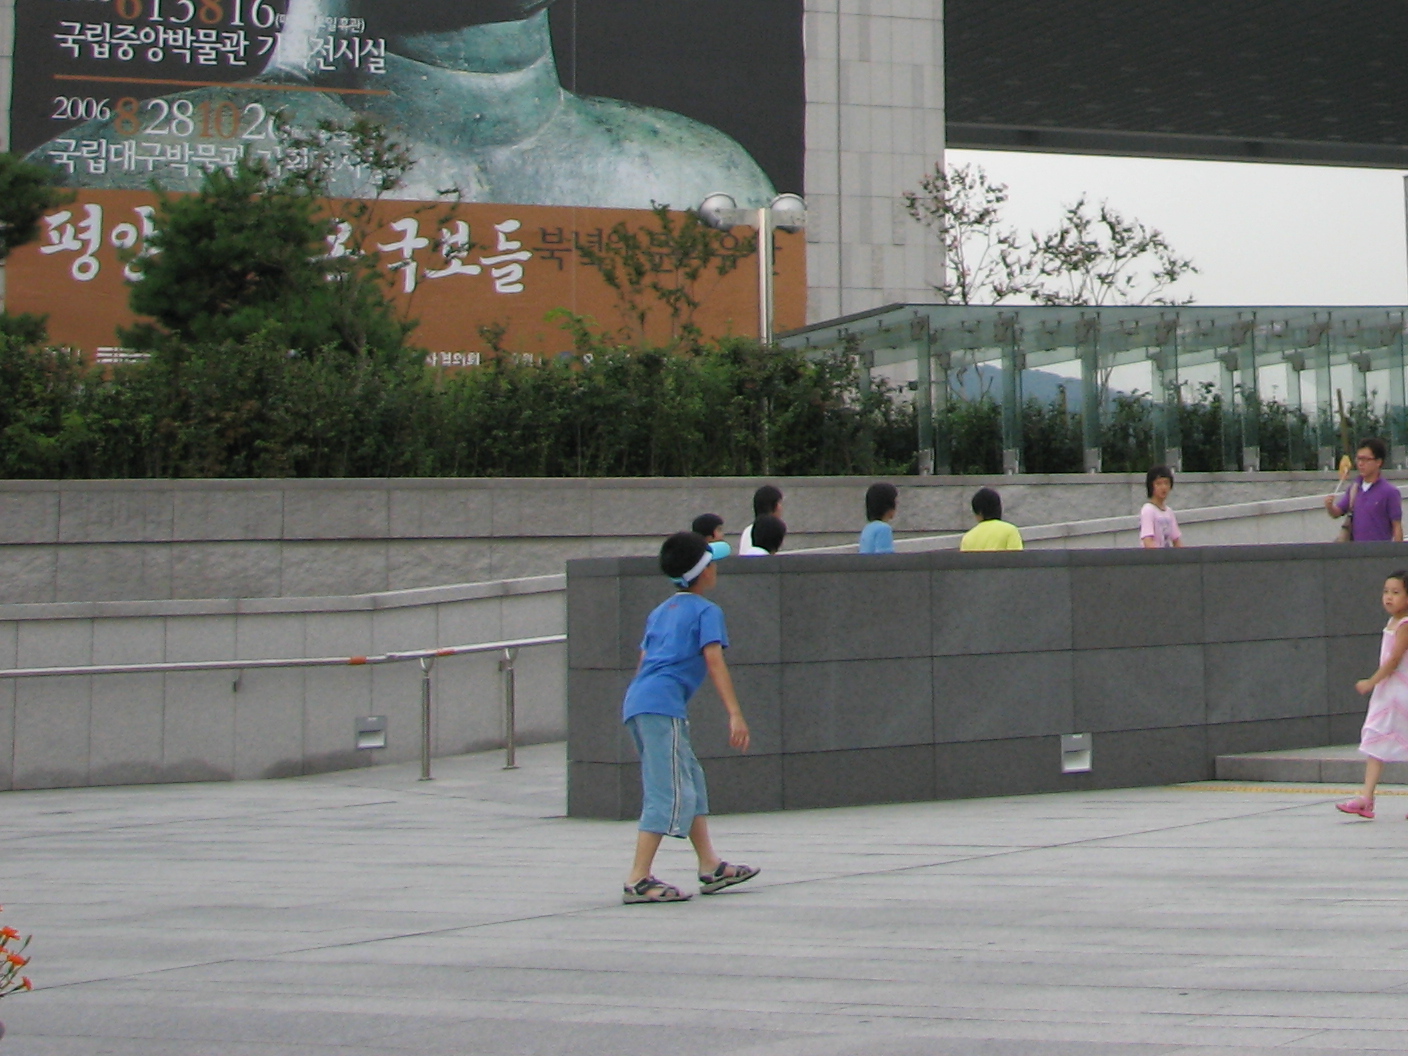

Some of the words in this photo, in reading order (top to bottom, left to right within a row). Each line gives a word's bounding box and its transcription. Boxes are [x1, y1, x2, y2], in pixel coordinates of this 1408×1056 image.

[53, 21, 250, 66] 국립중앙박물관
[257, 32, 387, 74] 기전시실
[51, 96, 111, 121] 2006
[40, 203, 164, 282] 평양
